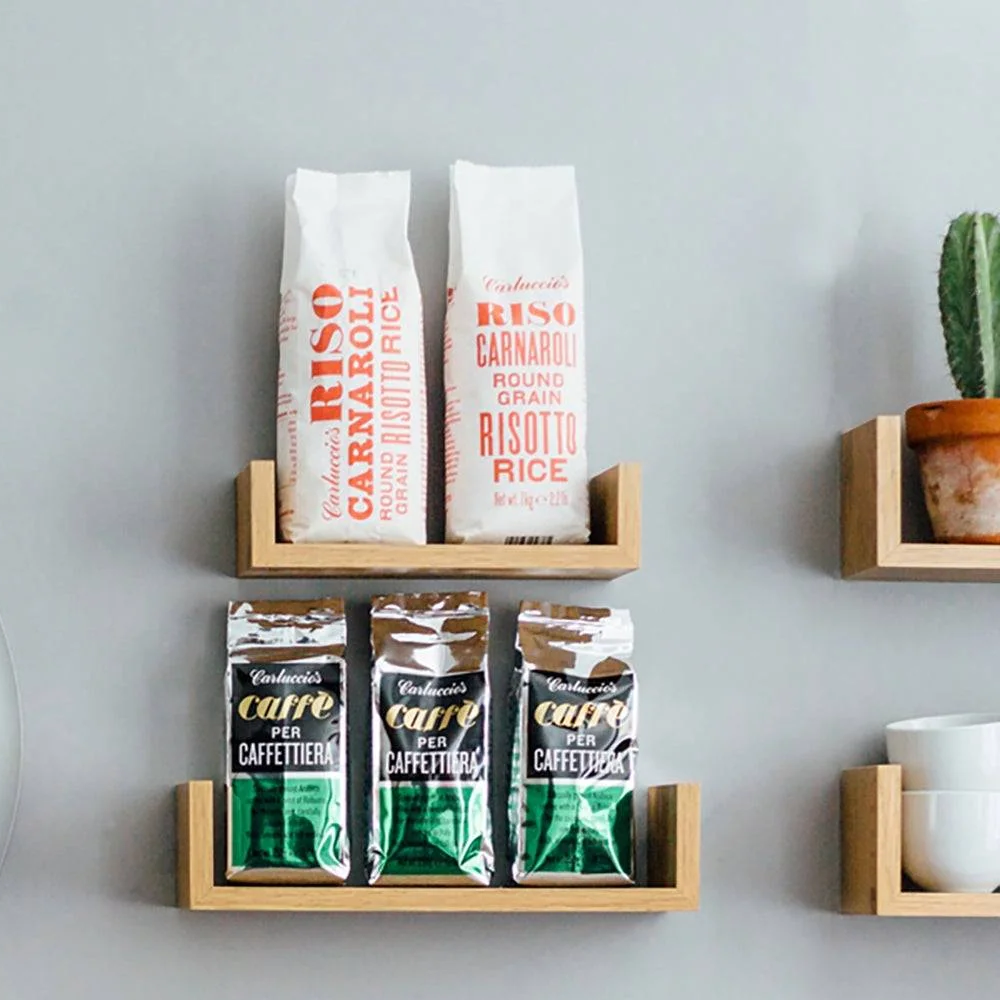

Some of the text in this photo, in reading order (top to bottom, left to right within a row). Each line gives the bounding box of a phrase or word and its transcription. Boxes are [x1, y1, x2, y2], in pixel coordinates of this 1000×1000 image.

[476, 302, 576, 327] RISO
[476, 331, 577, 368] CARNAROLI
[380, 286, 411, 445] RISOTTO RICE
[493, 372, 565, 388] ROUND
[310, 284, 344, 521] Carluccio's RISO
[348, 286, 374, 521] CARNAROLI
[498, 391, 562, 406] GRAIN
[479, 412, 577, 456] RISOTTO
[493, 459, 569, 482] RICE
[380, 452, 394, 521] ROUND
[396, 453, 409, 515] GRAIN
[249, 668, 322, 686] Carluccio's
[398, 679, 468, 697] Carluccio's
[546, 676, 618, 694] Carluccio's
[238, 690, 335, 721] caffè
[385, 699, 480, 733] caffè
[534, 699, 630, 729] caffè
[271, 726, 301, 739] PER
[417, 735, 447, 749] PER
[566, 734, 597, 747] PER
[238, 742, 334, 767] CAFFETTIERA
[385, 750, 478, 775] CAFFETTIERA
[533, 748, 625, 774] CAFFETTIERA
